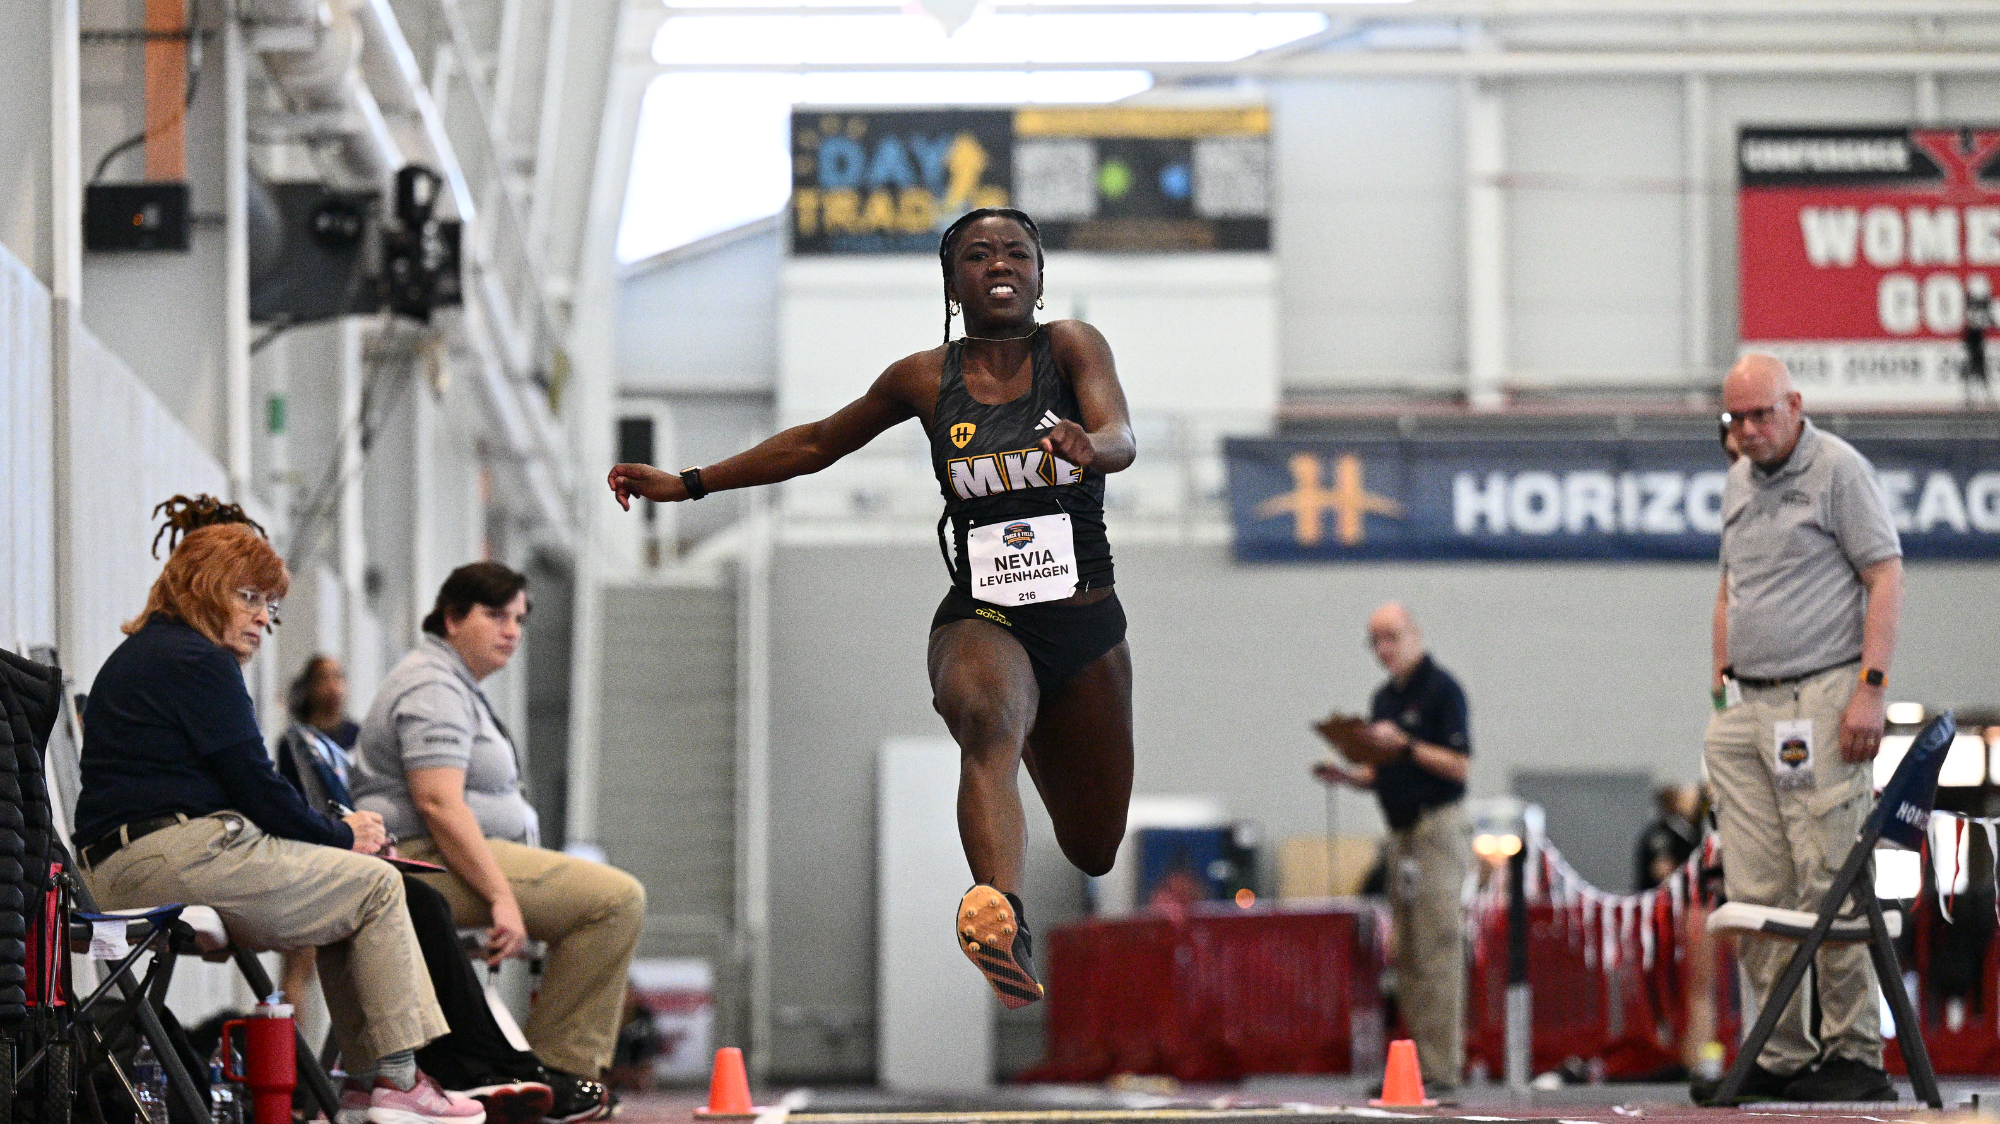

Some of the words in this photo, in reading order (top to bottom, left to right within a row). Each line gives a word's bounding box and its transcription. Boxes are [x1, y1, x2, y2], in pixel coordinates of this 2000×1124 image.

[817, 134, 953, 188] DAY
[1800, 205, 2000, 268] WOME
[1877, 272, 2000, 335] GO
[1454, 471, 1724, 534] HORIZO
[1879, 470, 2000, 534] EAG
[980, 564, 1069, 587] LEVENHAGEN
[994, 549, 1055, 572] NEVIA
[1018, 592, 1036, 601] 216
